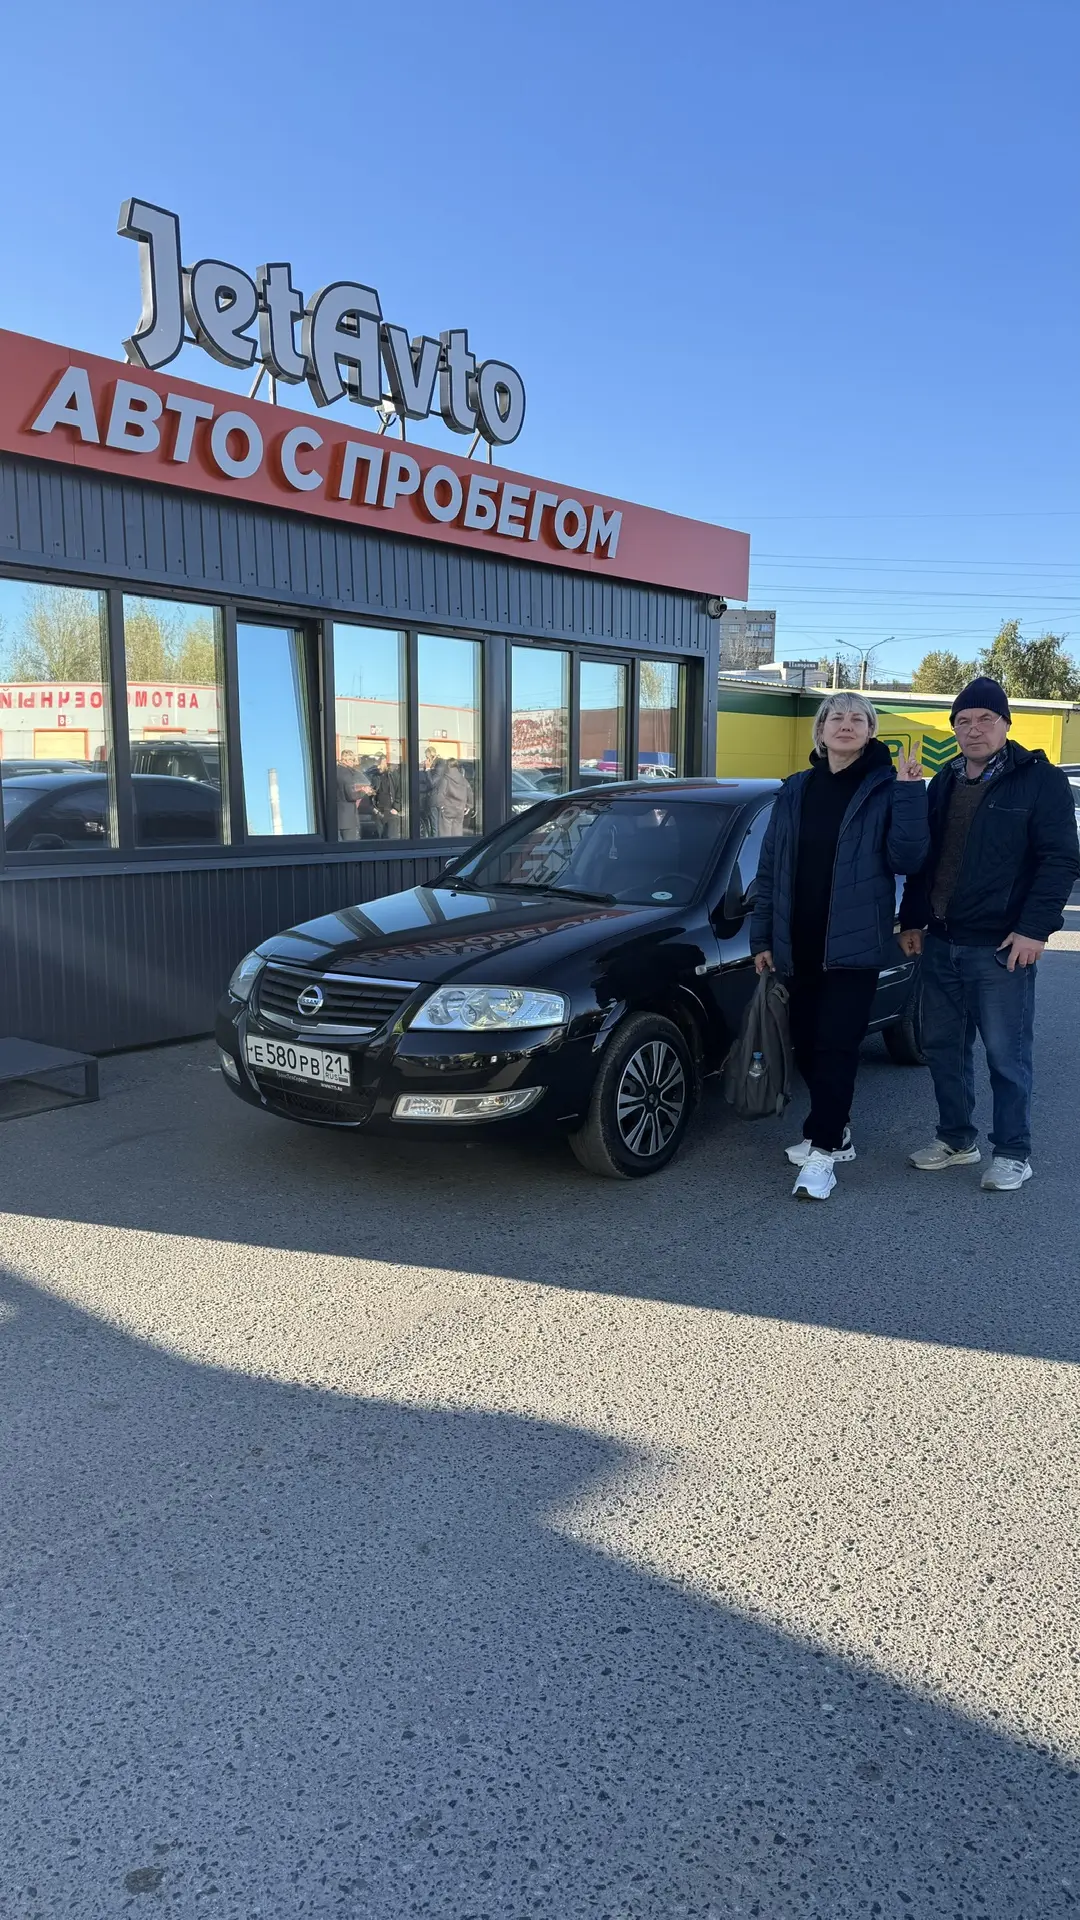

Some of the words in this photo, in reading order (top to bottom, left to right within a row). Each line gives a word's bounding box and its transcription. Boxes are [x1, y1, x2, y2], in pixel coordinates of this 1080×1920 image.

[116, 196, 526, 446] JetAvto
[30, 365, 264, 479] АВТО
[281, 426, 324, 491] С
[338, 440, 623, 559] ПРОБЕГОМ
[325, 1072, 338, 1081] RUS
